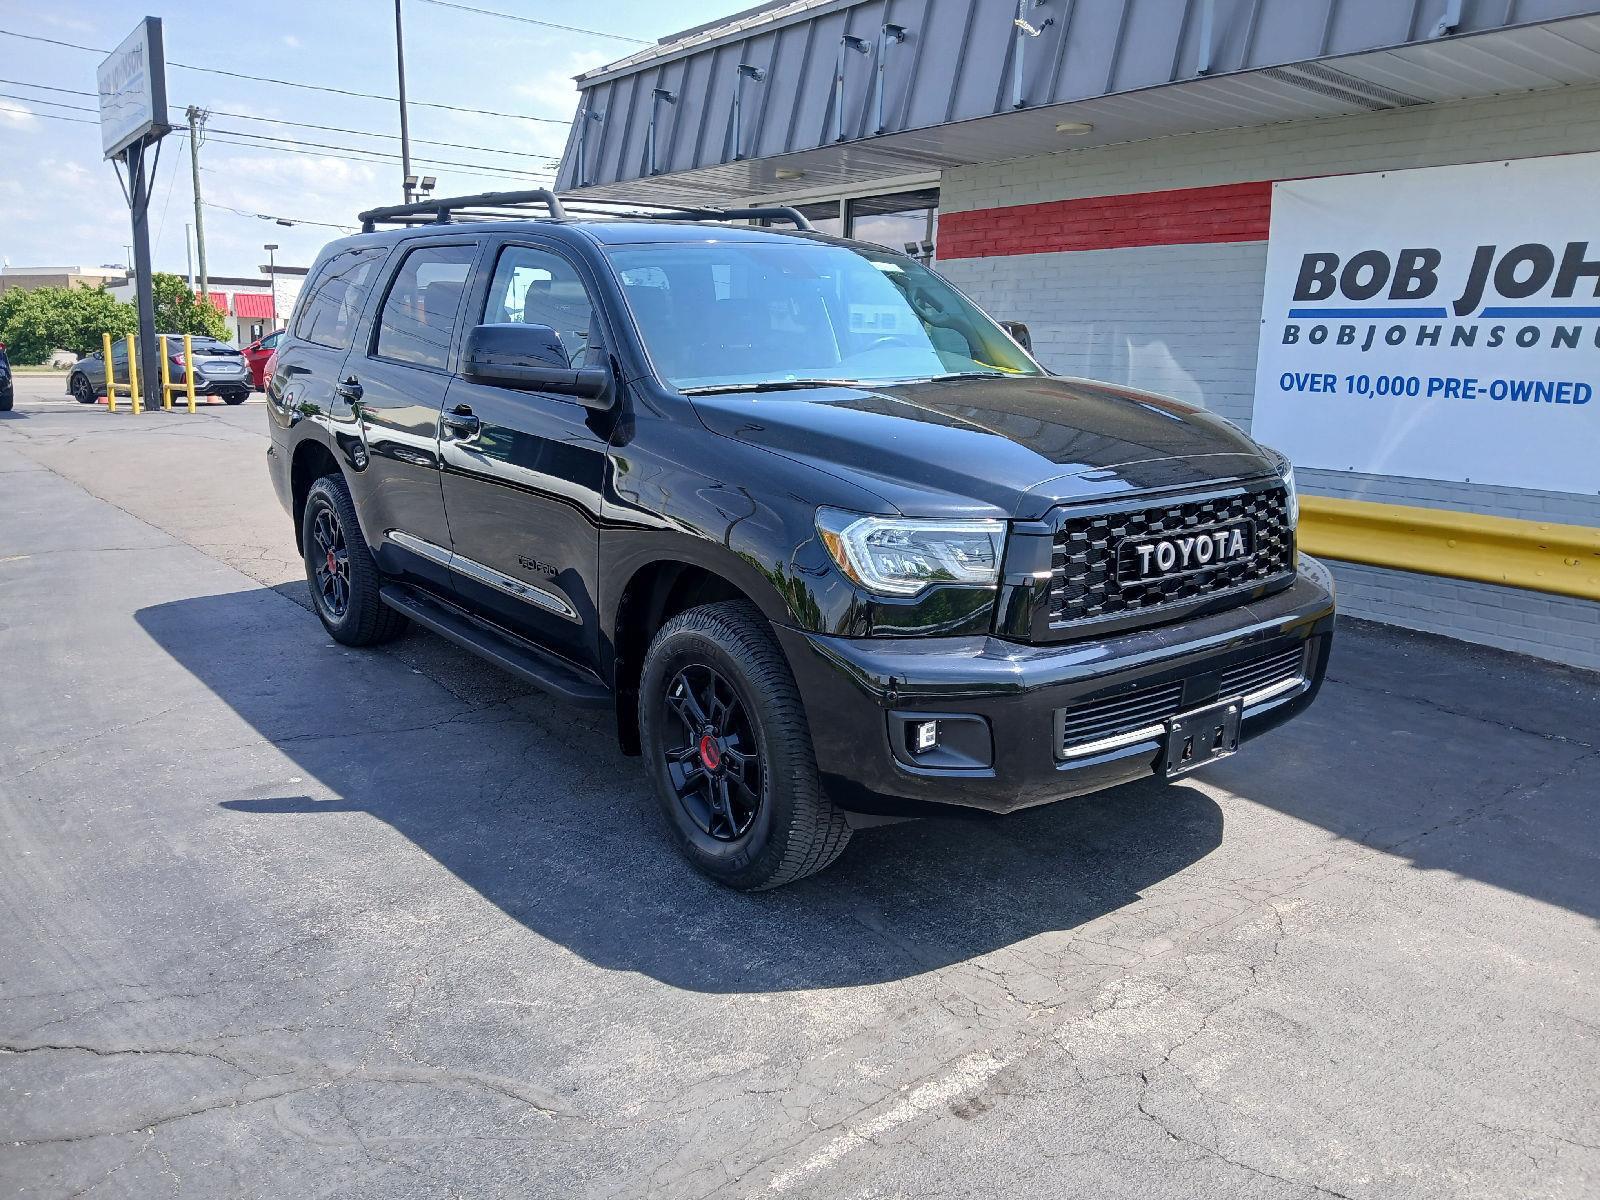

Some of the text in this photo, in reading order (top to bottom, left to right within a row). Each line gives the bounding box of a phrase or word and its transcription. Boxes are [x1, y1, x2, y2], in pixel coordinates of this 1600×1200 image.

[1292, 241, 1600, 317] BOB JOH
[1281, 324, 1600, 352] BOBJOHNSON
[1279, 372, 1593, 405] OVER 10,000 PRE-OWNED
[1136, 528, 1245, 574] TOYOTA
